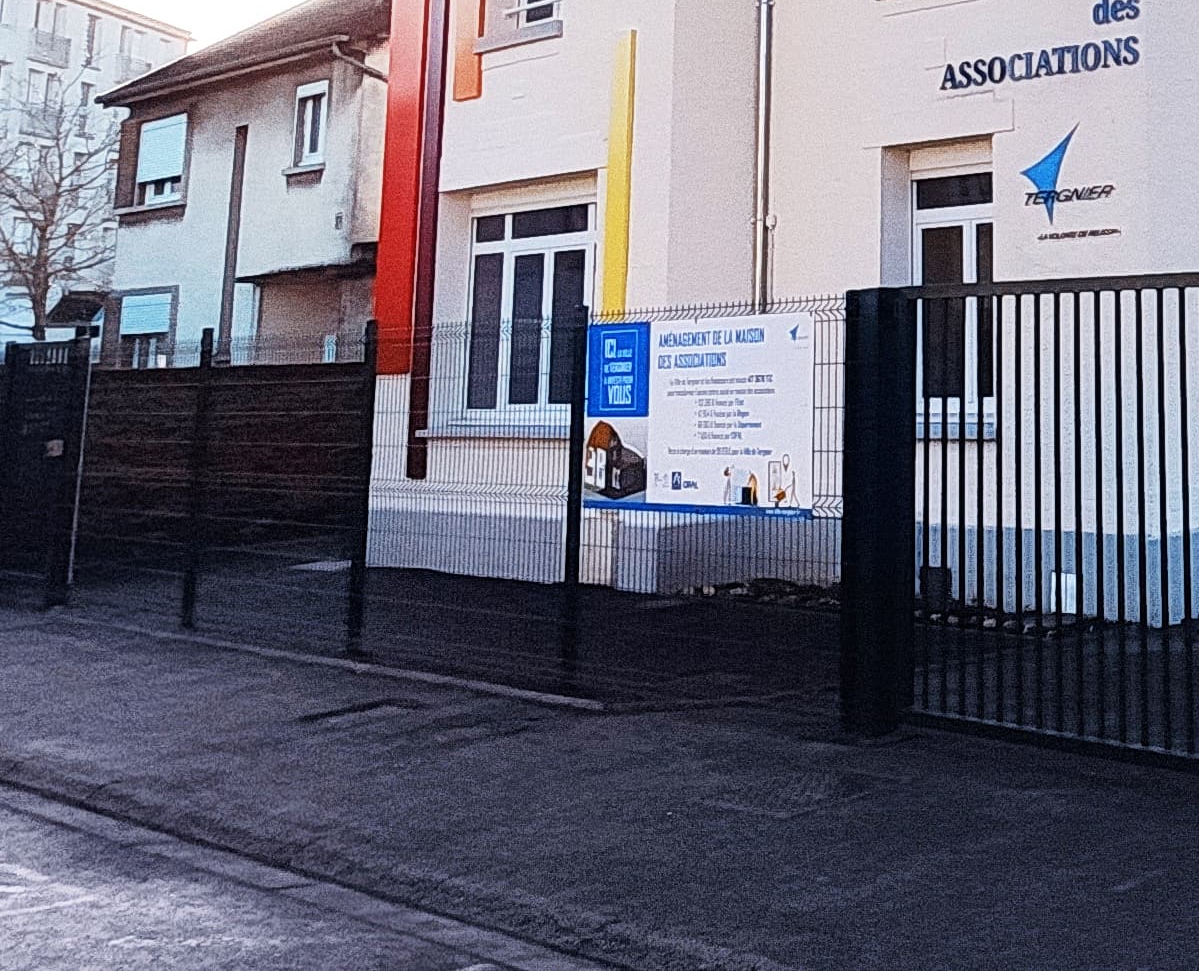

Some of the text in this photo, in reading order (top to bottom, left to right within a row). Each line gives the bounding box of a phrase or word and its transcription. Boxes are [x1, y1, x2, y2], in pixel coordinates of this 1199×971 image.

[940, 36, 1140, 90] ASSOCIATIONS
[1024, 184, 1116, 206] TERGNIER
[659, 327, 765, 348] AMÉNAGEMENT DE LA MAISON
[604, 338, 617, 359] ICI
[658, 352, 727, 369] DES ASSOCIATIONS
[608, 384, 632, 405] VOUS
